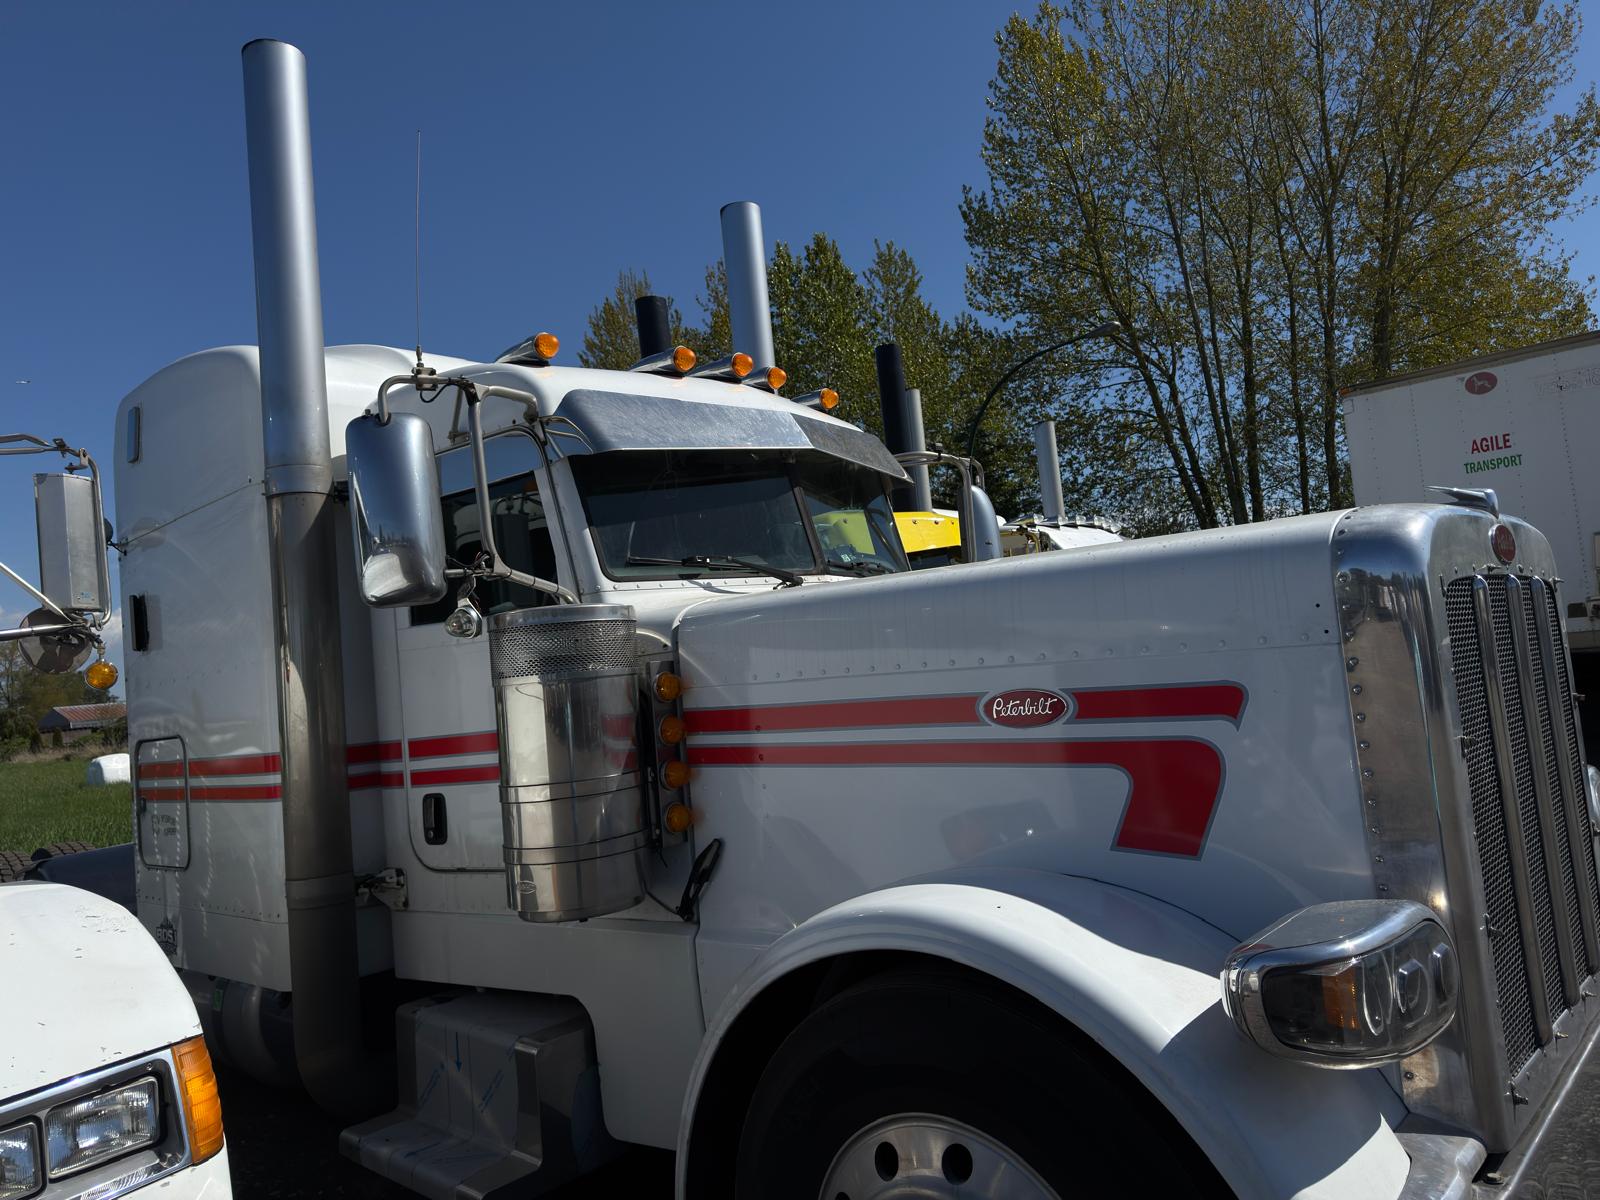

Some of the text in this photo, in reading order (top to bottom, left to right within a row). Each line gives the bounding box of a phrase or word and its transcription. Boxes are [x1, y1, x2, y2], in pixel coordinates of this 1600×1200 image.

[1471, 433, 1512, 454] AGILE
[1463, 454, 1522, 474] TRANSPORT
[993, 698, 1057, 718] Peterbilt
